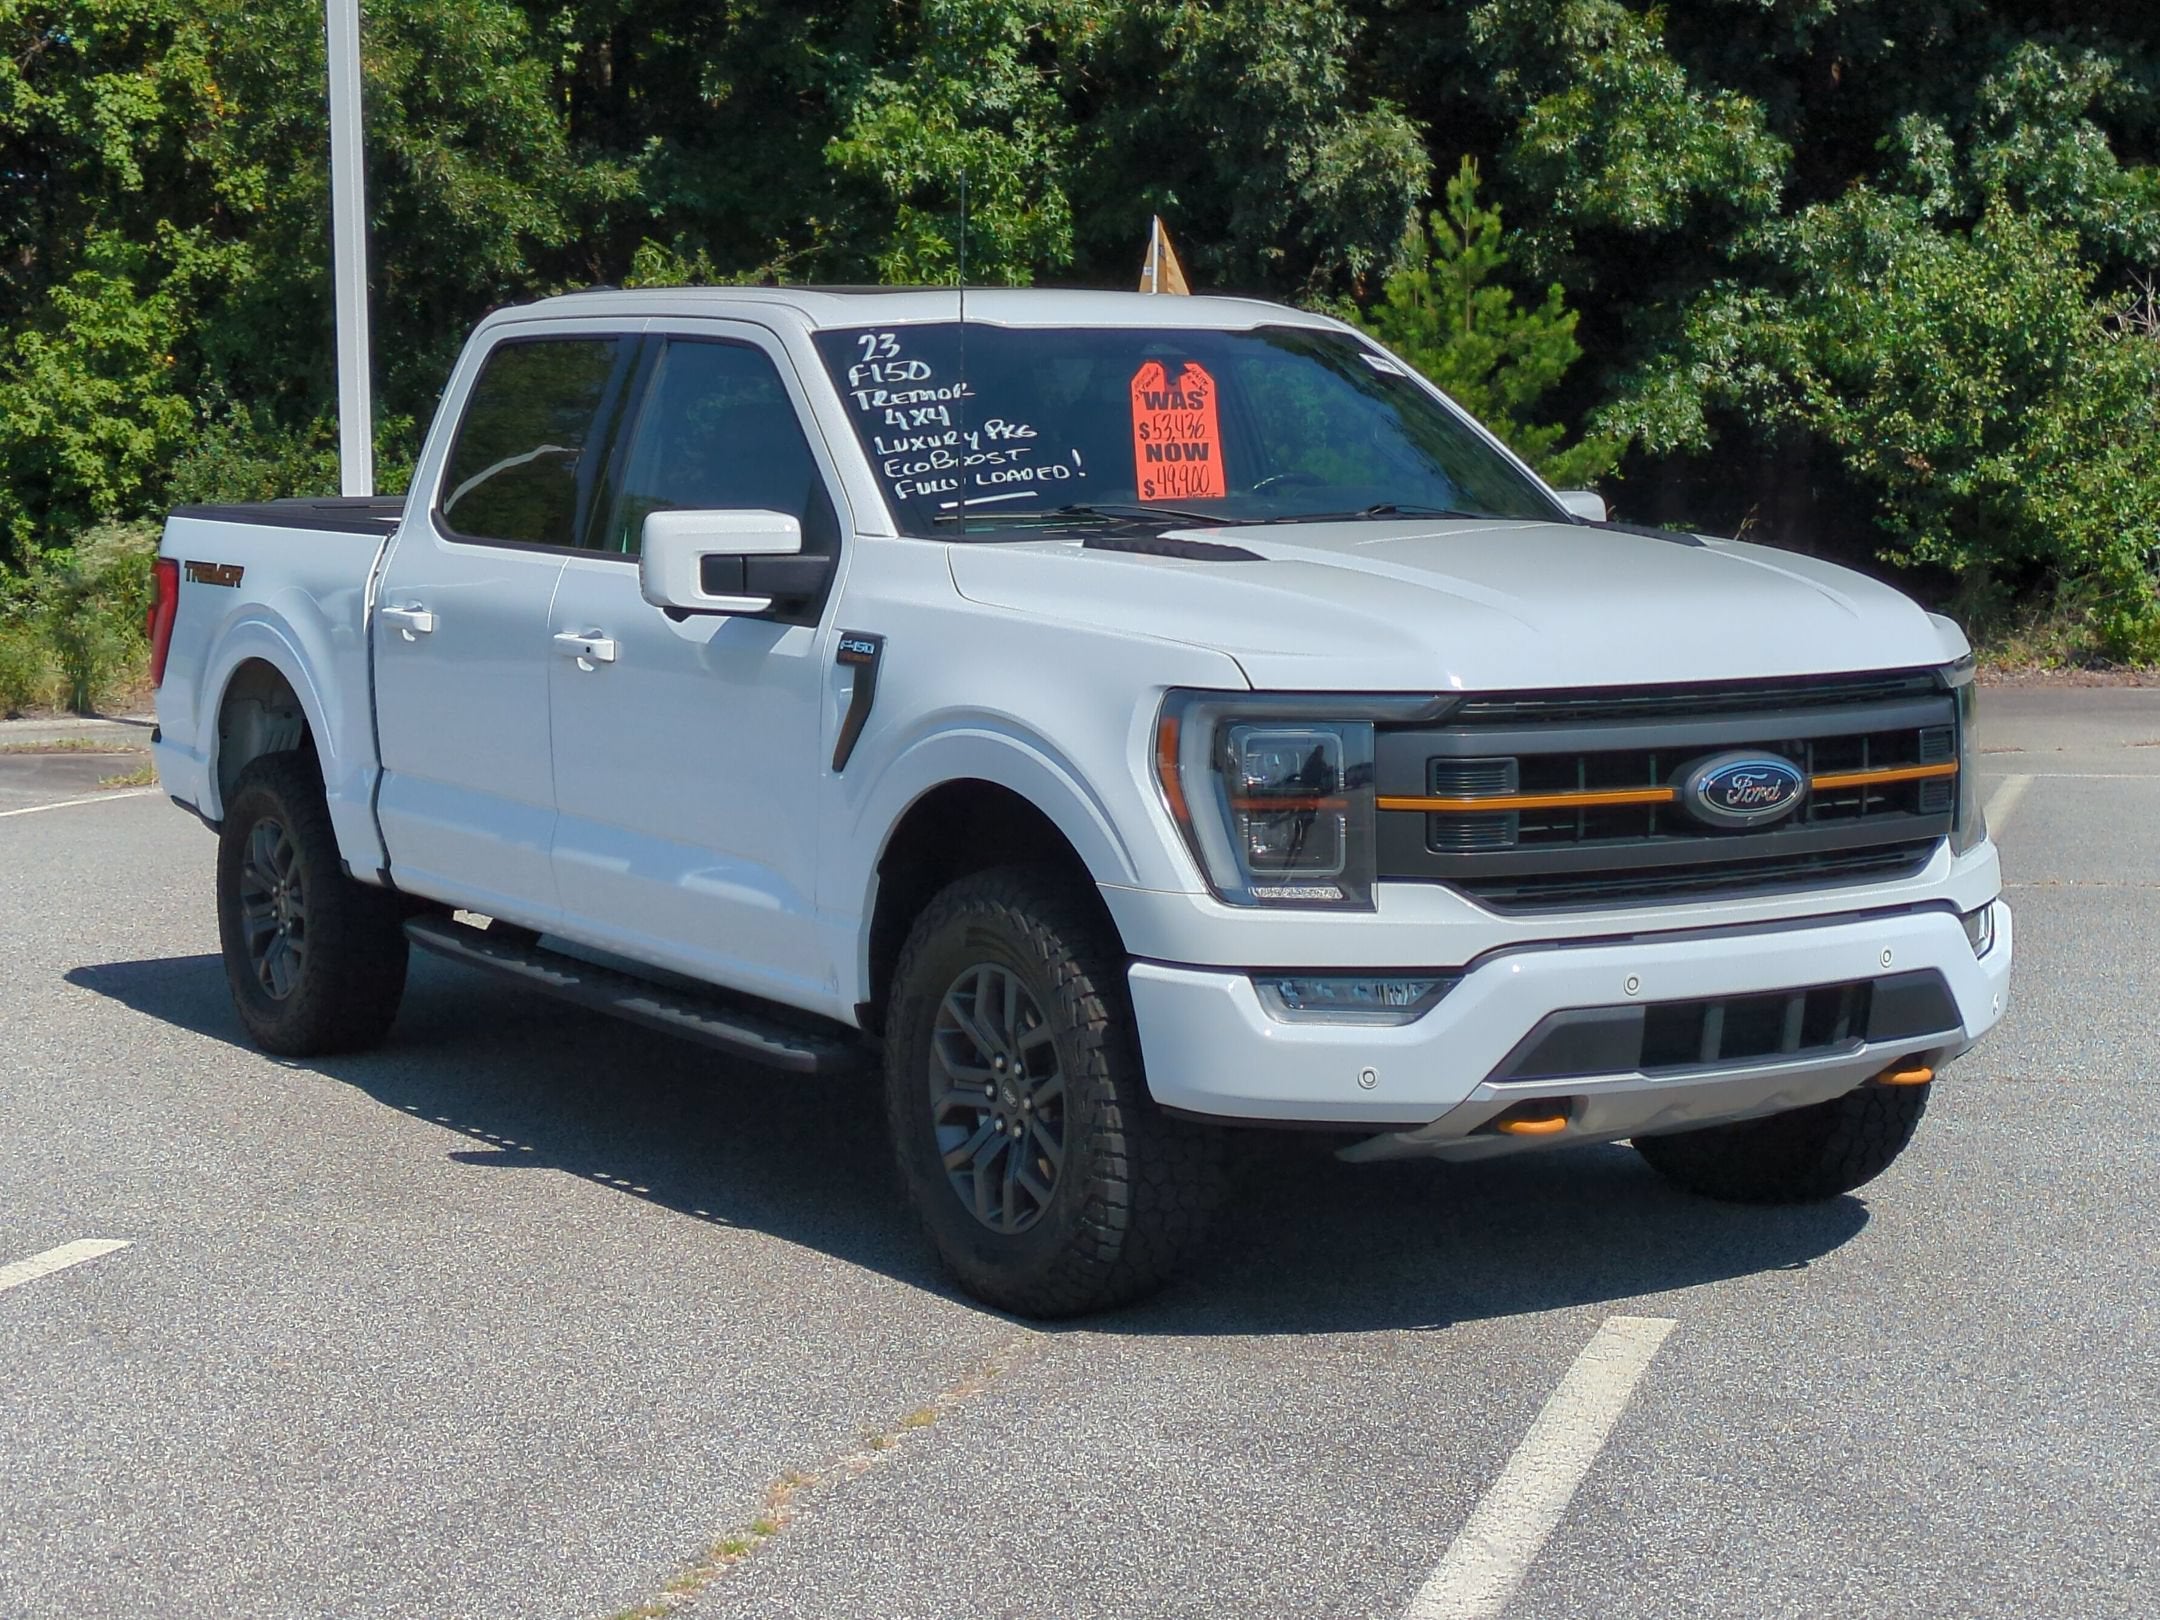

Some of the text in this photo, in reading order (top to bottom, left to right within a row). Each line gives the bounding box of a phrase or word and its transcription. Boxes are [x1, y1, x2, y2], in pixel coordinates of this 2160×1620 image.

[858, 333, 900, 361] 23
[848, 360, 932, 387] F150
[849, 382, 976, 411] TREMOR
[1142, 391, 1204, 410] WAS
[874, 418, 1038, 455] LUXURY PKG
[1145, 442, 1209, 462] NOW
[976, 448, 1086, 486] LOADED!
[184, 560, 245, 588] TREMOR
[1726, 773, 1781, 805] Ford
